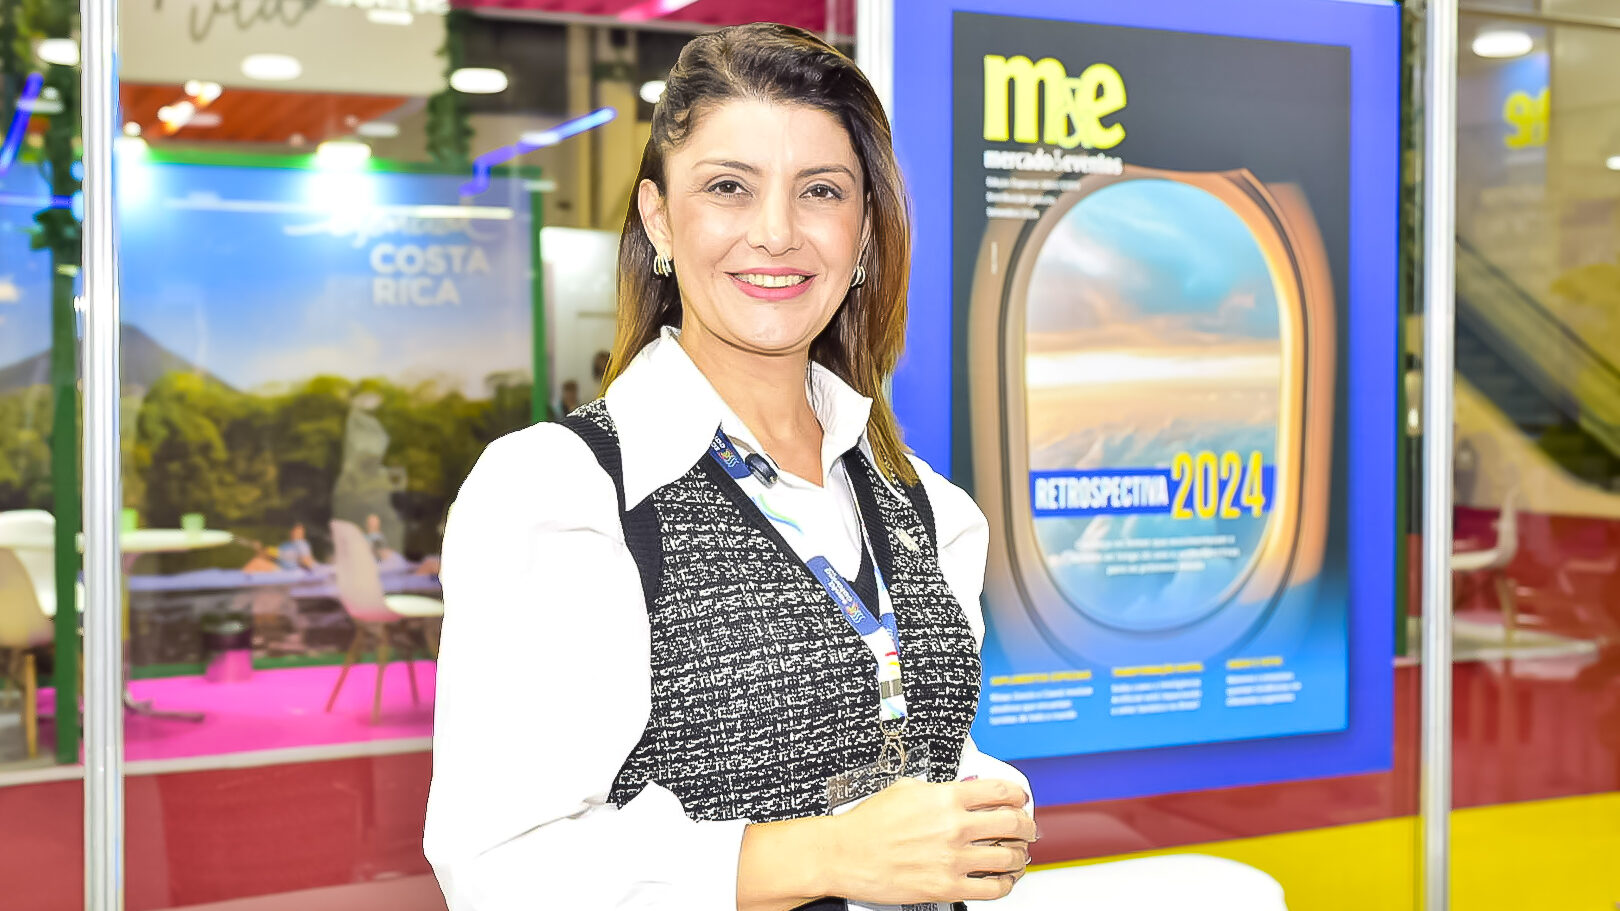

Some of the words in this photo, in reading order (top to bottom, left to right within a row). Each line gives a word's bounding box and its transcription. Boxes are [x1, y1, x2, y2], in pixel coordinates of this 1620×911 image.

[370, 243, 489, 275] COSTA
[373, 277, 461, 306] RICA
[1034, 475, 1169, 509] RETROSPECTIVA
[1171, 451, 1265, 519] 2024
